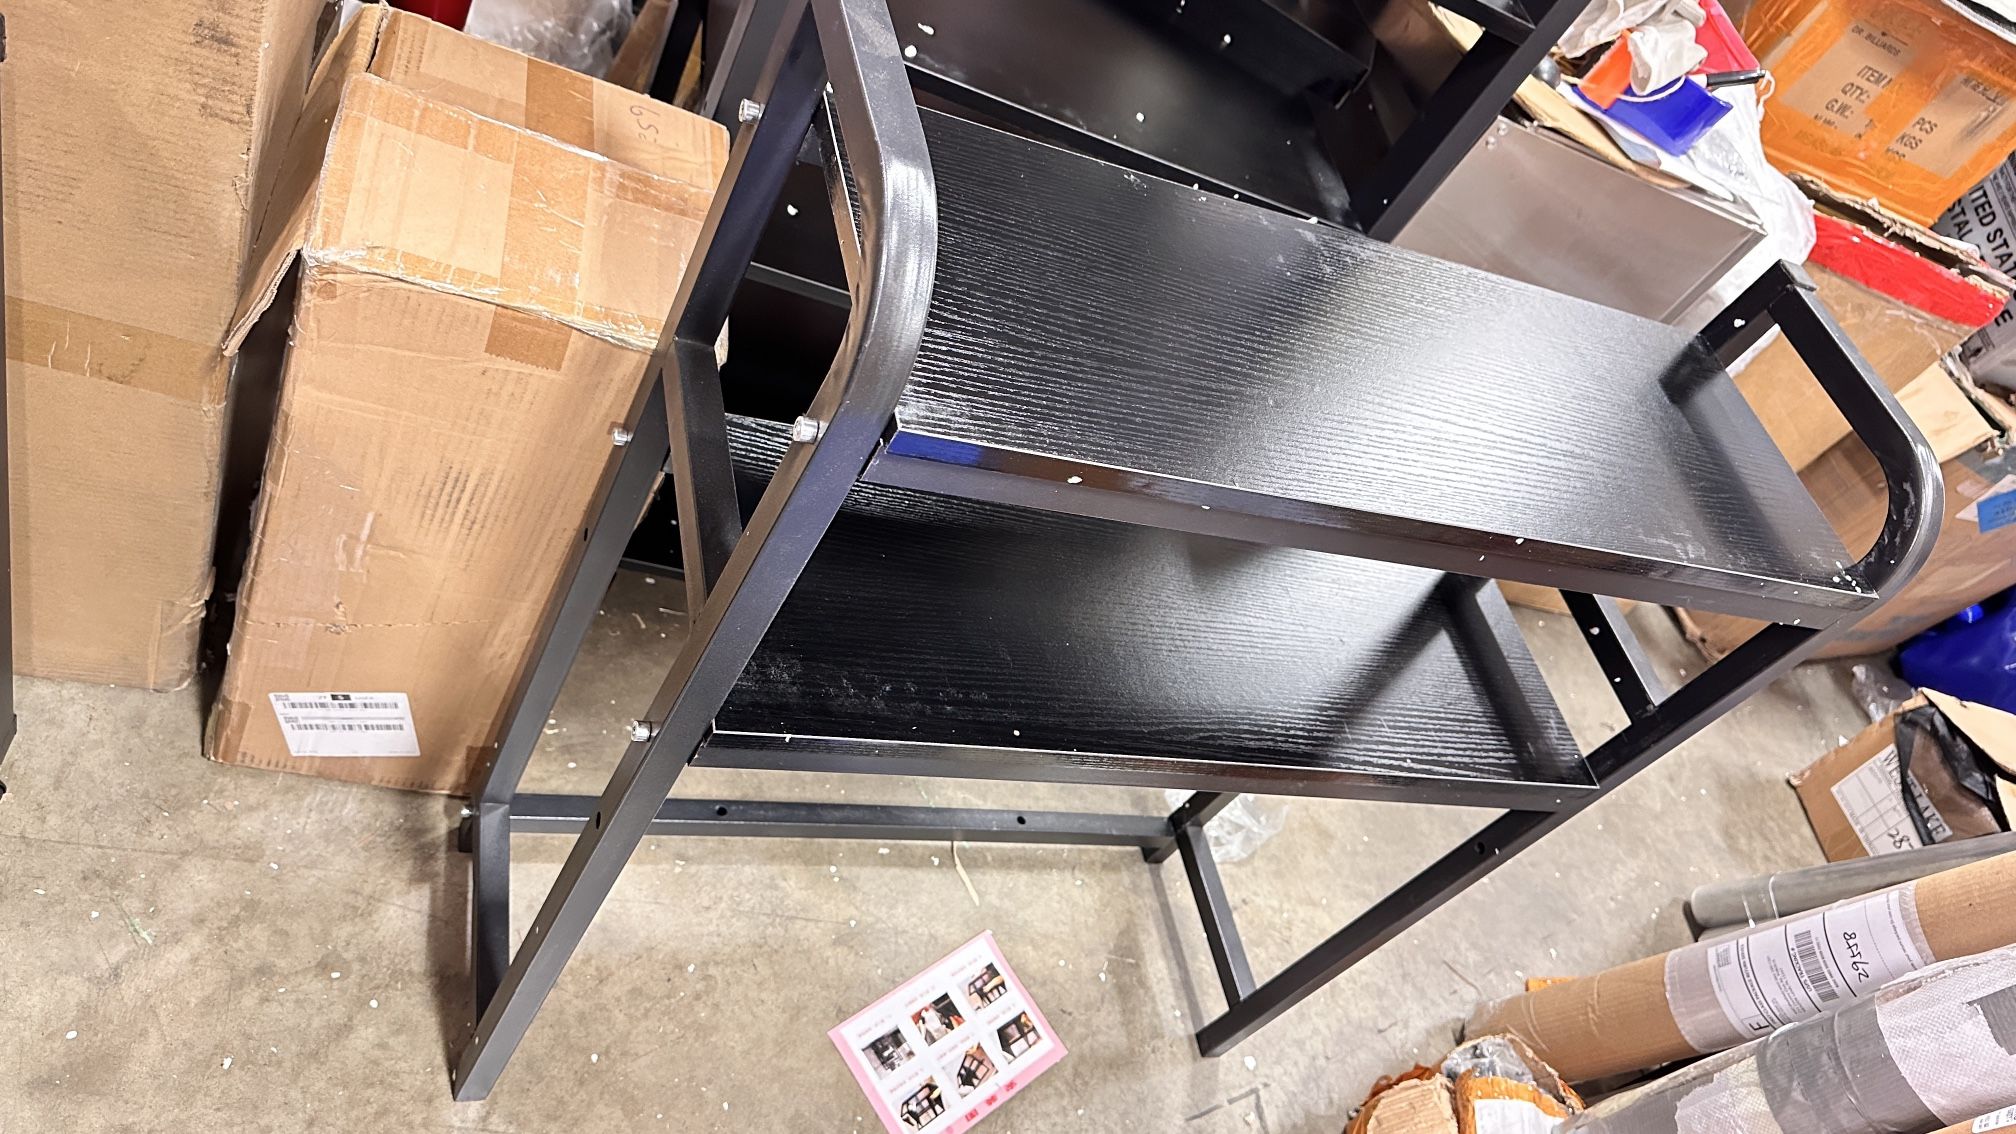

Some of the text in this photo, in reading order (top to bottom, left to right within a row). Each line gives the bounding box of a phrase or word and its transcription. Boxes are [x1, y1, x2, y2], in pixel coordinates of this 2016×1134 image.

[1912, 117, 1938, 135] PCS
[1896, 132, 1923, 150] KGS
[1947, 198, 1973, 241] STAL
[1968, 185, 1997, 228] ITED
[1887, 827, 1914, 850] 28
[1790, 950, 1806, 979] TRACKING
[1843, 931, 1869, 983] 29558
[1748, 1021, 1770, 1032] F
